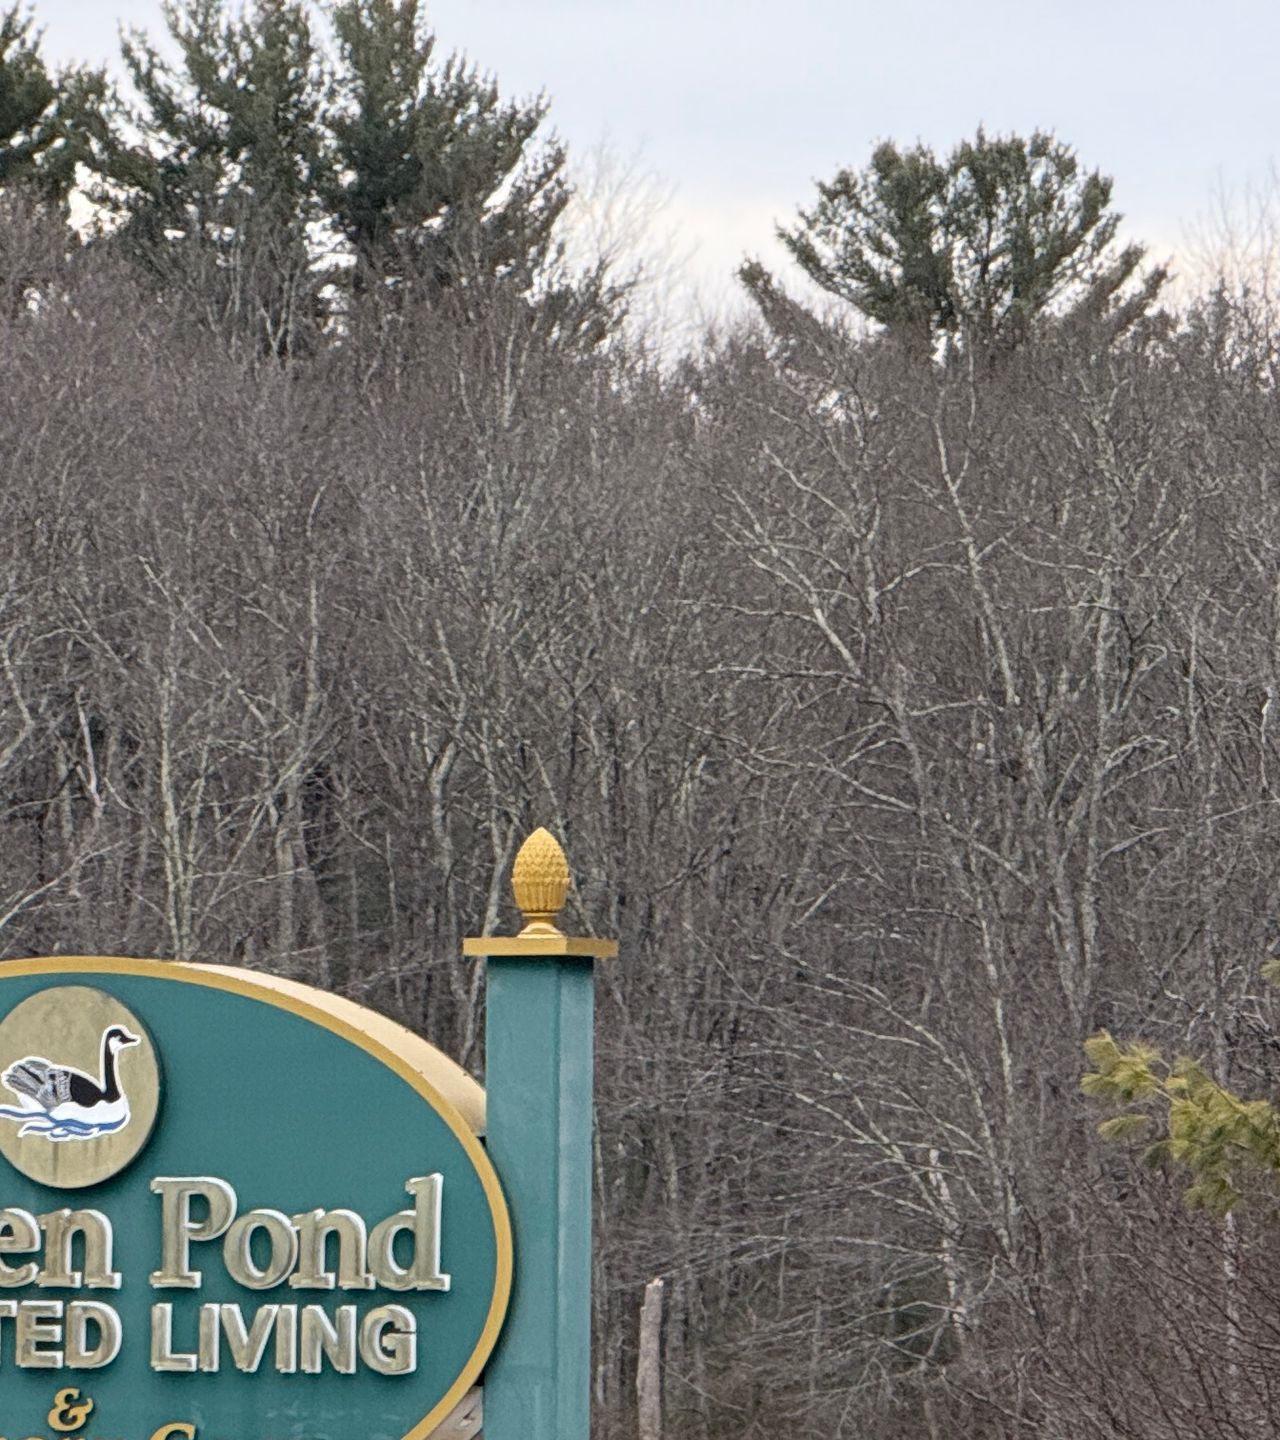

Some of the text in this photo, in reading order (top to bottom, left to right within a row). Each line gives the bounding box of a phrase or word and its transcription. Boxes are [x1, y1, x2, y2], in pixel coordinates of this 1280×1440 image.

[150, 1173, 450, 1291] Pond
[151, 1303, 417, 1374] LIVING
[48, 1388, 93, 1432] &
